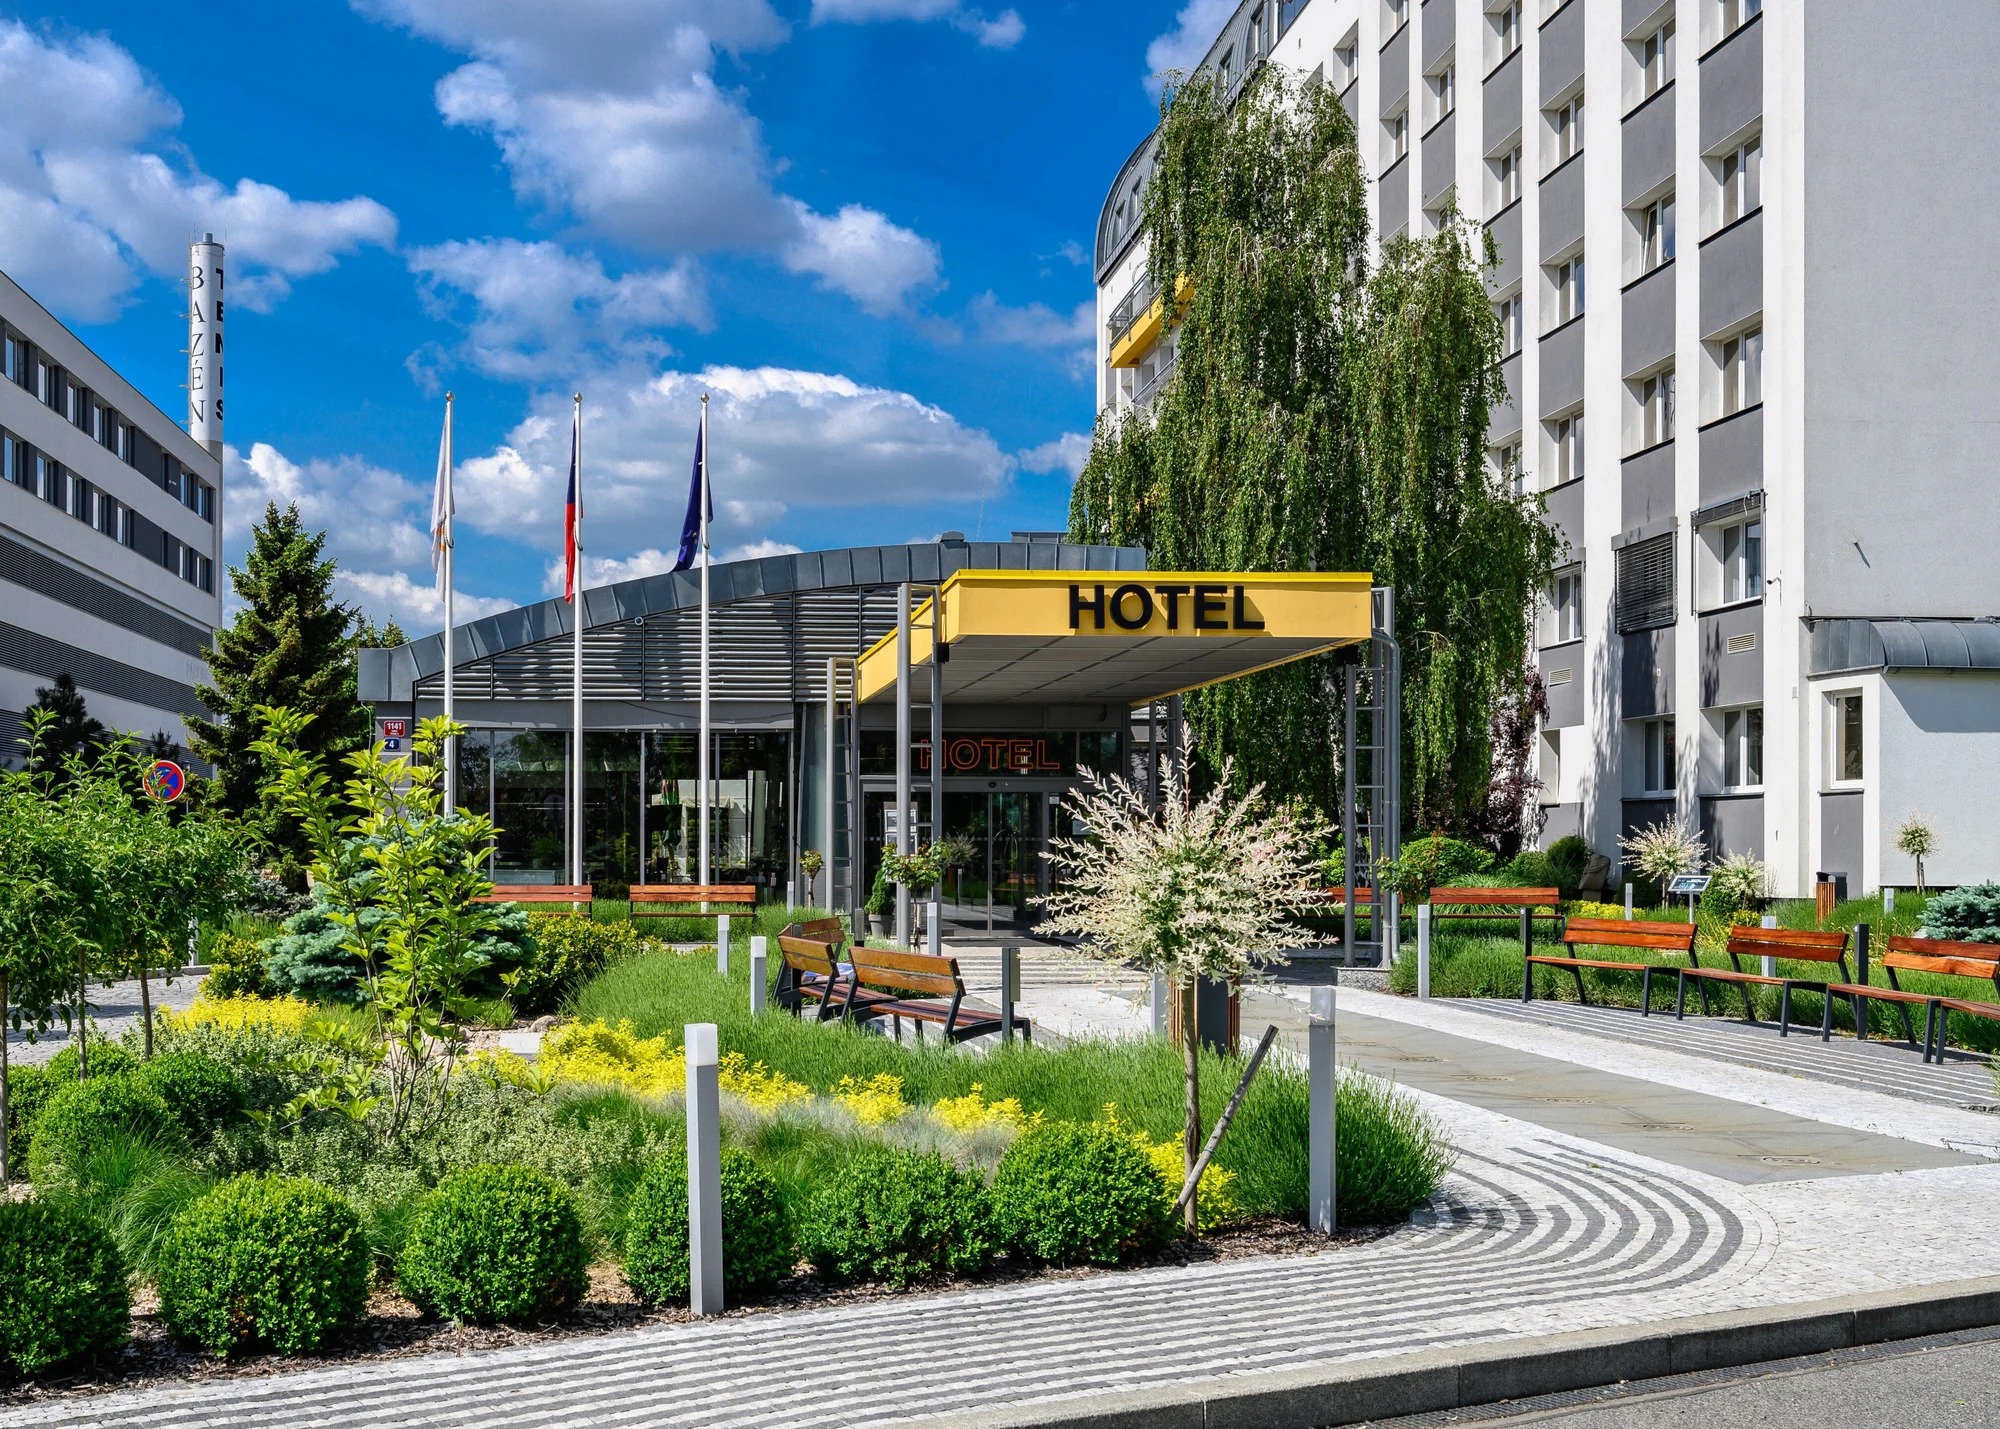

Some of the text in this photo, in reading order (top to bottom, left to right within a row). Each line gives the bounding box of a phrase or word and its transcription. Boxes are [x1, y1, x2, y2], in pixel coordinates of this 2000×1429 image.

[191, 266, 206, 424] BAZÉN
[1069, 584, 1265, 630] HOTEL
[387, 722, 402, 730] 1141
[389, 740, 395, 748] 4
[920, 739, 1060, 770] HOTEL
